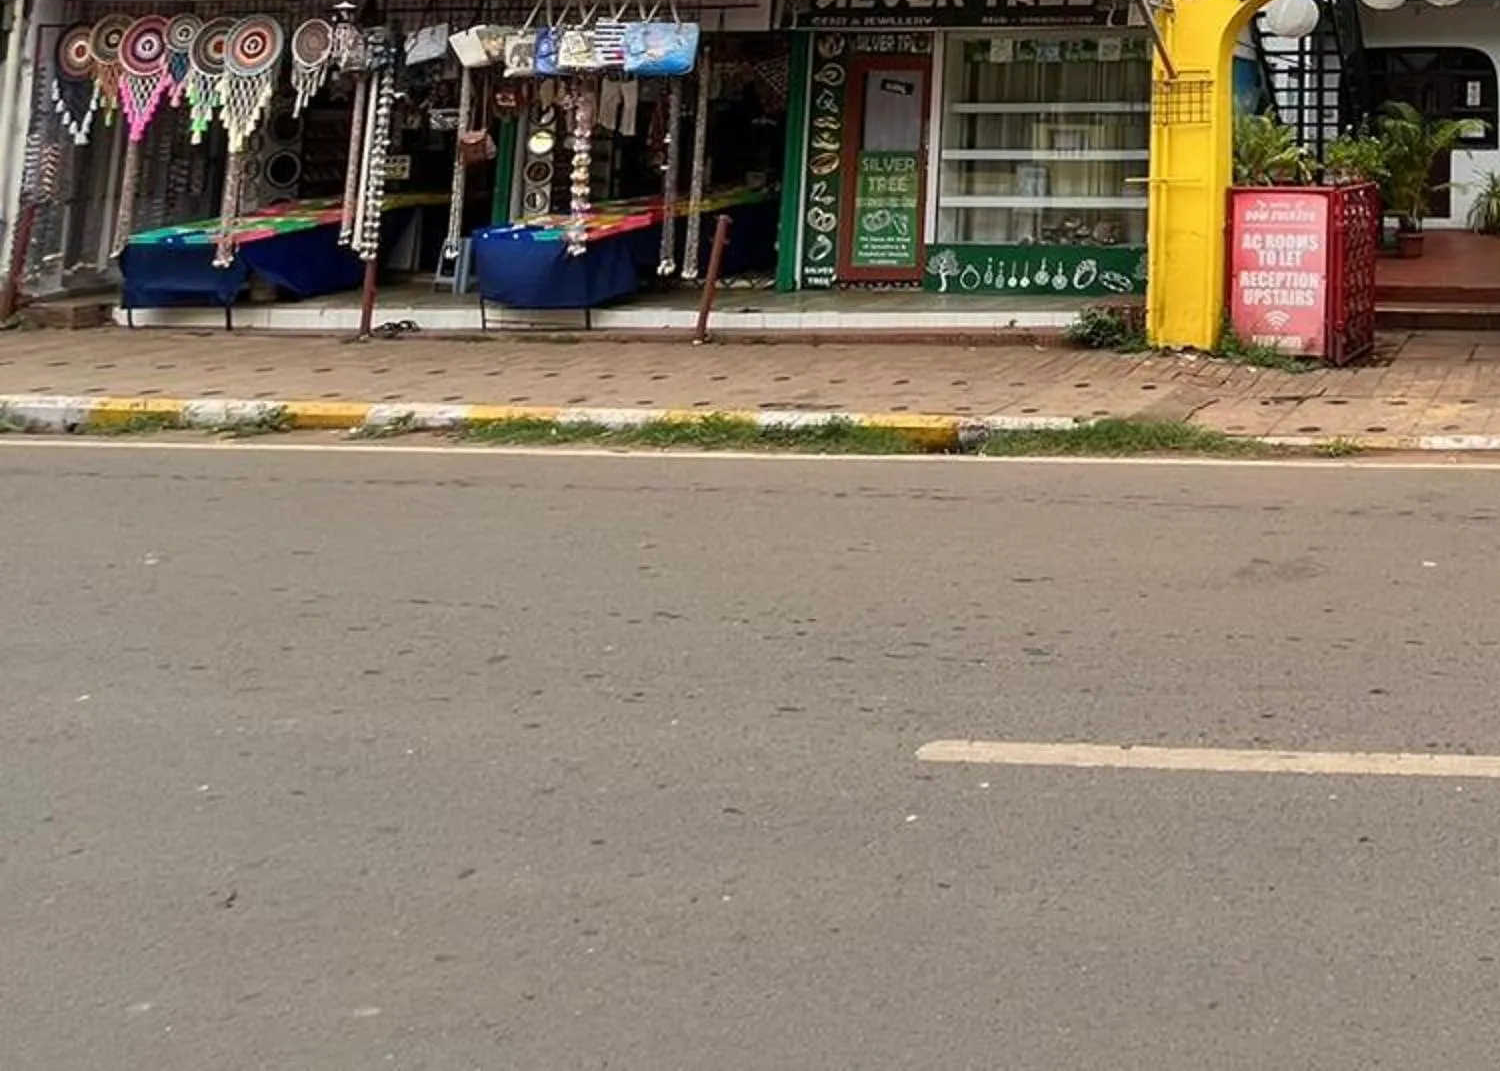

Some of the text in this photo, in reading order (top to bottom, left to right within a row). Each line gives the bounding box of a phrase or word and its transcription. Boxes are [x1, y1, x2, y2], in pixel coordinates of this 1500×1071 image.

[862, 157, 916, 172] SILVER
[867, 176, 909, 192] TREE
[1242, 233, 1319, 251] AC ROOMS
[1258, 250, 1303, 267] TO LET
[1240, 271, 1319, 288] RECEPTION
[1243, 289, 1315, 306] UPSTAIRS
